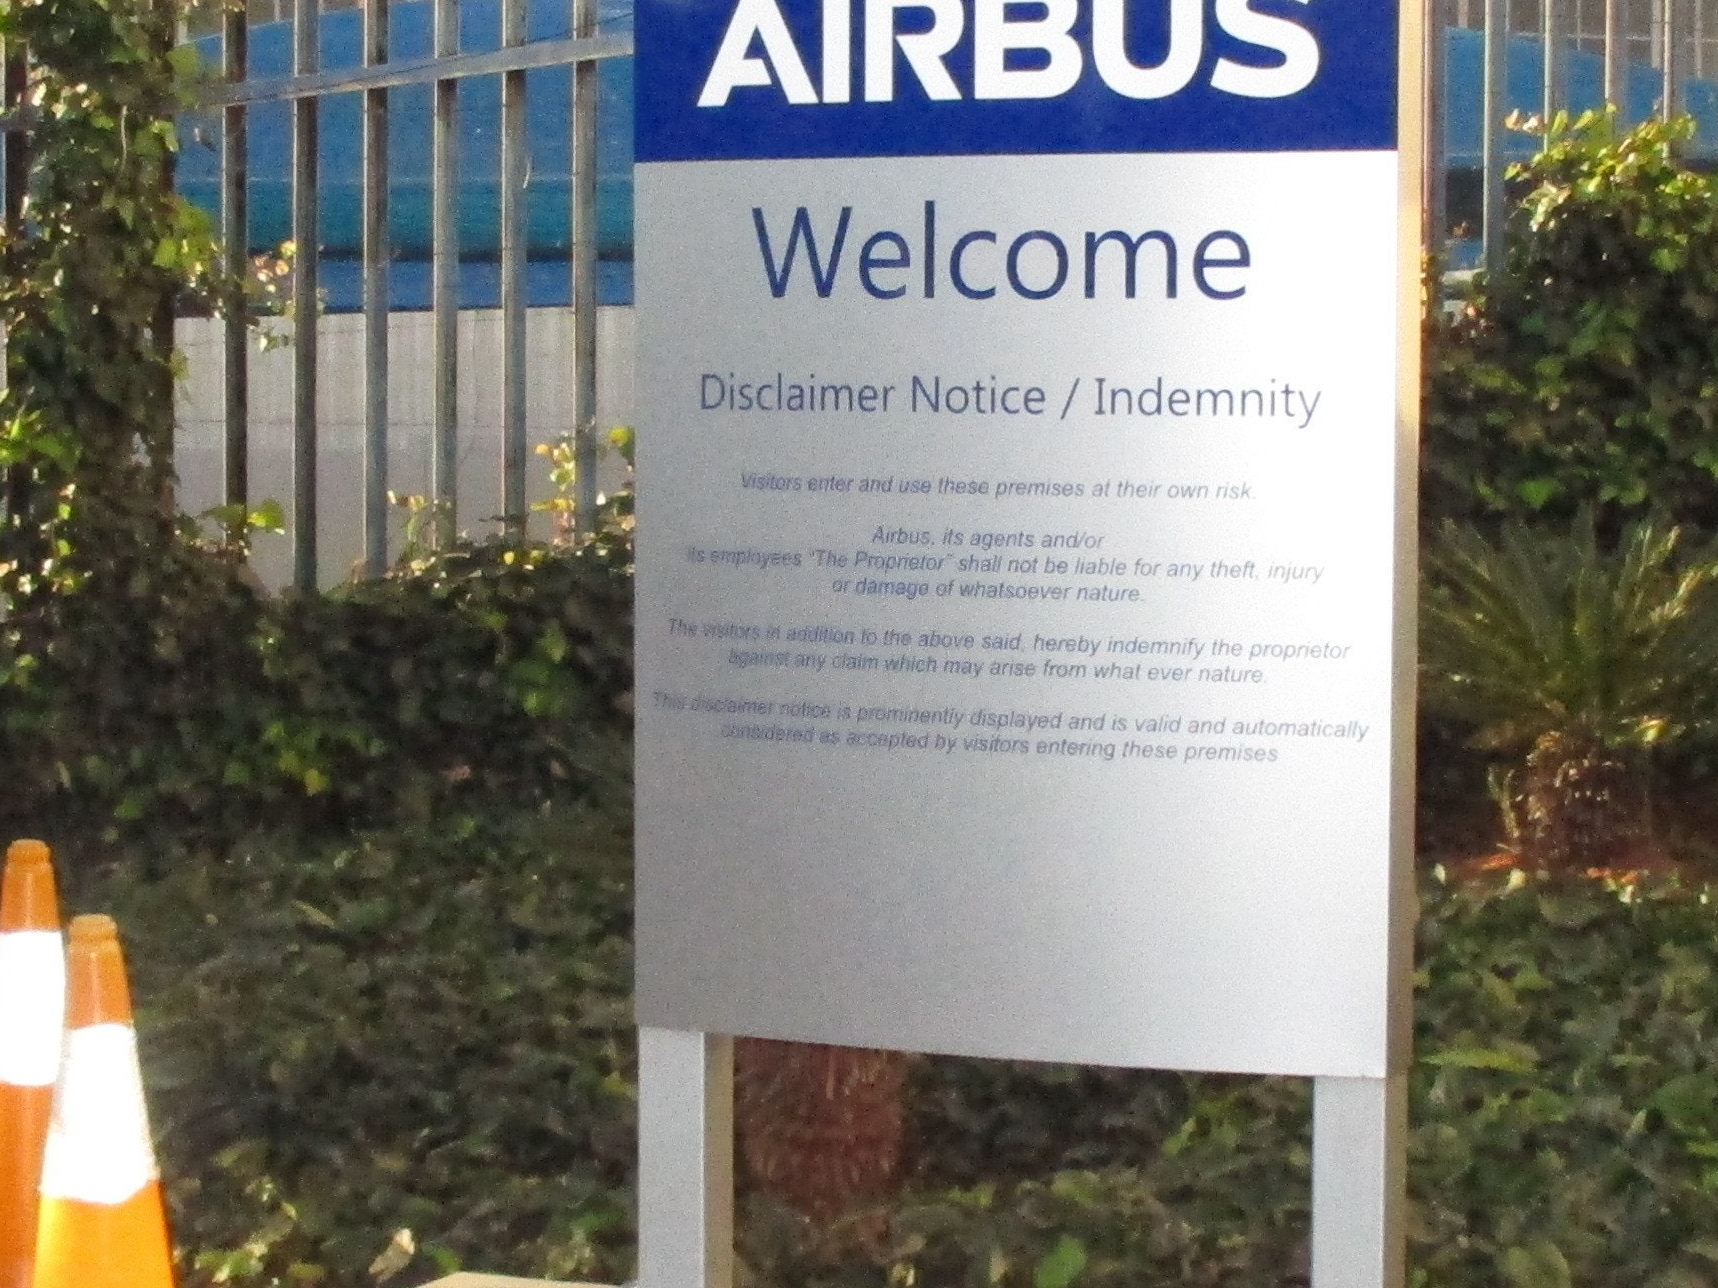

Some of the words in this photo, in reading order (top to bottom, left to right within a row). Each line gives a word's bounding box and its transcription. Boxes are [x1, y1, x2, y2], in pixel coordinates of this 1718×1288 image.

[752, 200, 1252, 300] Welcome
[700, 372, 895, 413] Disclaimer
[911, 374, 1046, 415] Notice
[1060, 376, 1081, 420] /
[1094, 376, 1322, 429] Indemnity
[741, 472, 802, 492] Visitors
[807, 475, 854, 493] enter
[859, 475, 893, 493] and
[899, 479, 932, 494] use
[938, 477, 989, 495] these
[994, 479, 1084, 499] premises
[1092, 480, 1111, 497] at
[1117, 479, 1163, 498] their
[1167, 484, 1209, 500] own
[1215, 481, 1257, 500] risk.
[942, 528, 964, 546] its
[970, 530, 1034, 551] agents
[1041, 530, 1105, 549] and/or
[710, 548, 802, 569] employees
[958, 554, 1002, 573] shall
[1007, 557, 1039, 574] not
[1044, 556, 1068, 575] be
[1074, 558, 1127, 576] liable
[1133, 558, 1161, 576] for
[1166, 563, 1204, 582] any
[1267, 561, 1324, 584] injury
[833, 579, 851, 593] or
[855, 578, 929, 600] damage
[935, 580, 954, 597] of
[959, 581, 1071, 600] whatsoever
[1076, 585, 1145, 602] nature.
[669, 618, 697, 638] The
[766, 624, 781, 640] in
[786, 626, 854, 644] addition
[861, 628, 878, 645] to
[883, 629, 912, 647] the
[918, 630, 975, 649] above
[1034, 634, 1102, 656] hereby
[1107, 637, 1205, 660] indemnify
[1211, 638, 1243, 656] the
[1249, 641, 1352, 662] proprietor
[796, 654, 827, 671] any
[833, 653, 879, 670] claim
[885, 656, 938, 673] which
[943, 661, 983, 677] may
[989, 660, 1036, 677] arise
[1043, 659, 1087, 678] from
[1094, 662, 1140, 680] what
[1147, 667, 1193, 682] ever
[1198, 665, 1267, 684] nature.
[779, 701, 832, 719] notice
[837, 703, 851, 720] is
[857, 706, 965, 729] prominently
[969, 709, 1063, 732] displayed
[1068, 714, 1106, 731] and
[1112, 715, 1128, 731] is
[1135, 715, 1182, 733] valid
[1187, 717, 1227, 734] and
[1232, 719, 1370, 742] automatically
[818, 731, 840, 745] as
[846, 730, 929, 749] accepted
[935, 733, 957, 754] by
[964, 734, 1030, 753] visitors
[1036, 738, 1116, 761] entering
[1123, 740, 1178, 759] these
[1184, 746, 1279, 763] premises
